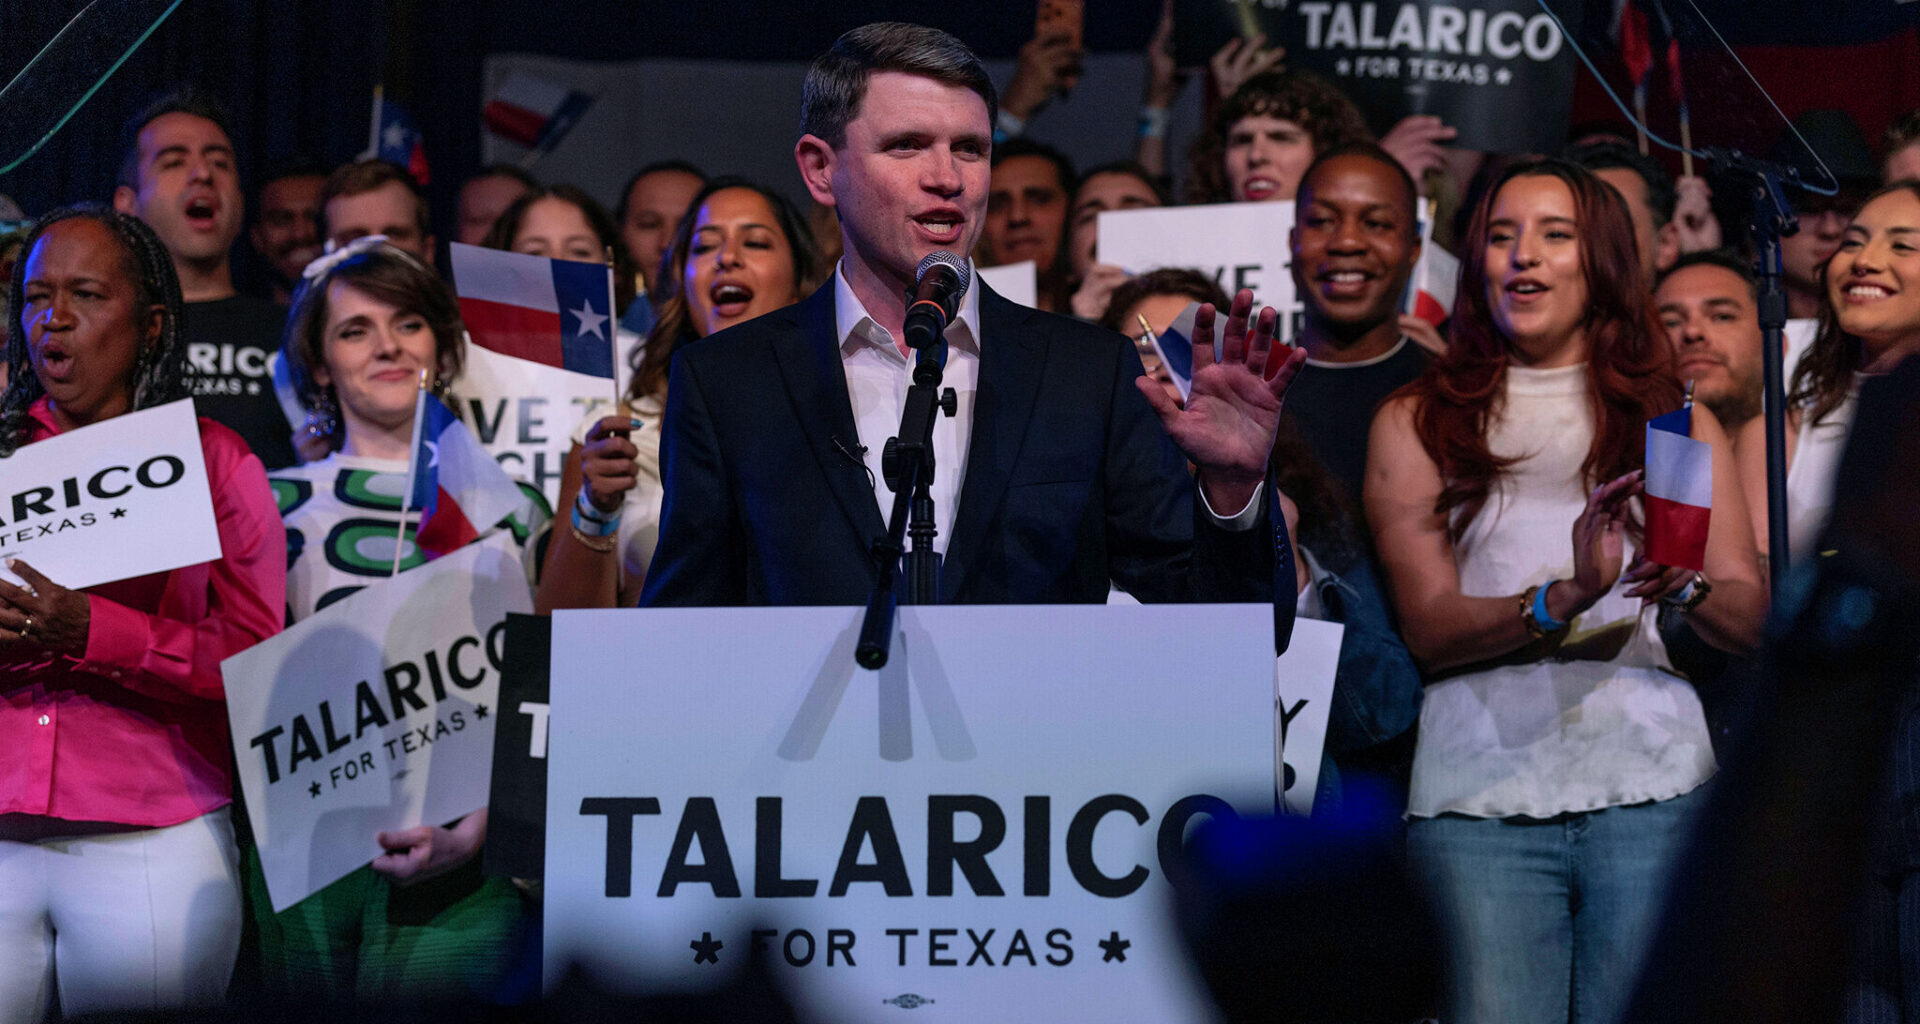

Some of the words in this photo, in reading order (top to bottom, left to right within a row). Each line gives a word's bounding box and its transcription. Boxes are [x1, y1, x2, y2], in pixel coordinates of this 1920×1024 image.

[1298, 2, 1563, 62] TALARICO
[1355, 56, 1401, 79] FOR
[1407, 57, 1490, 86] TEXAS
[181, 343, 281, 378] RIC
[0, 455, 185, 528] RICO
[329, 752, 376, 789] FOR
[383, 711, 466, 761] TEXAS
[885, 927, 1074, 967] TEXAS
